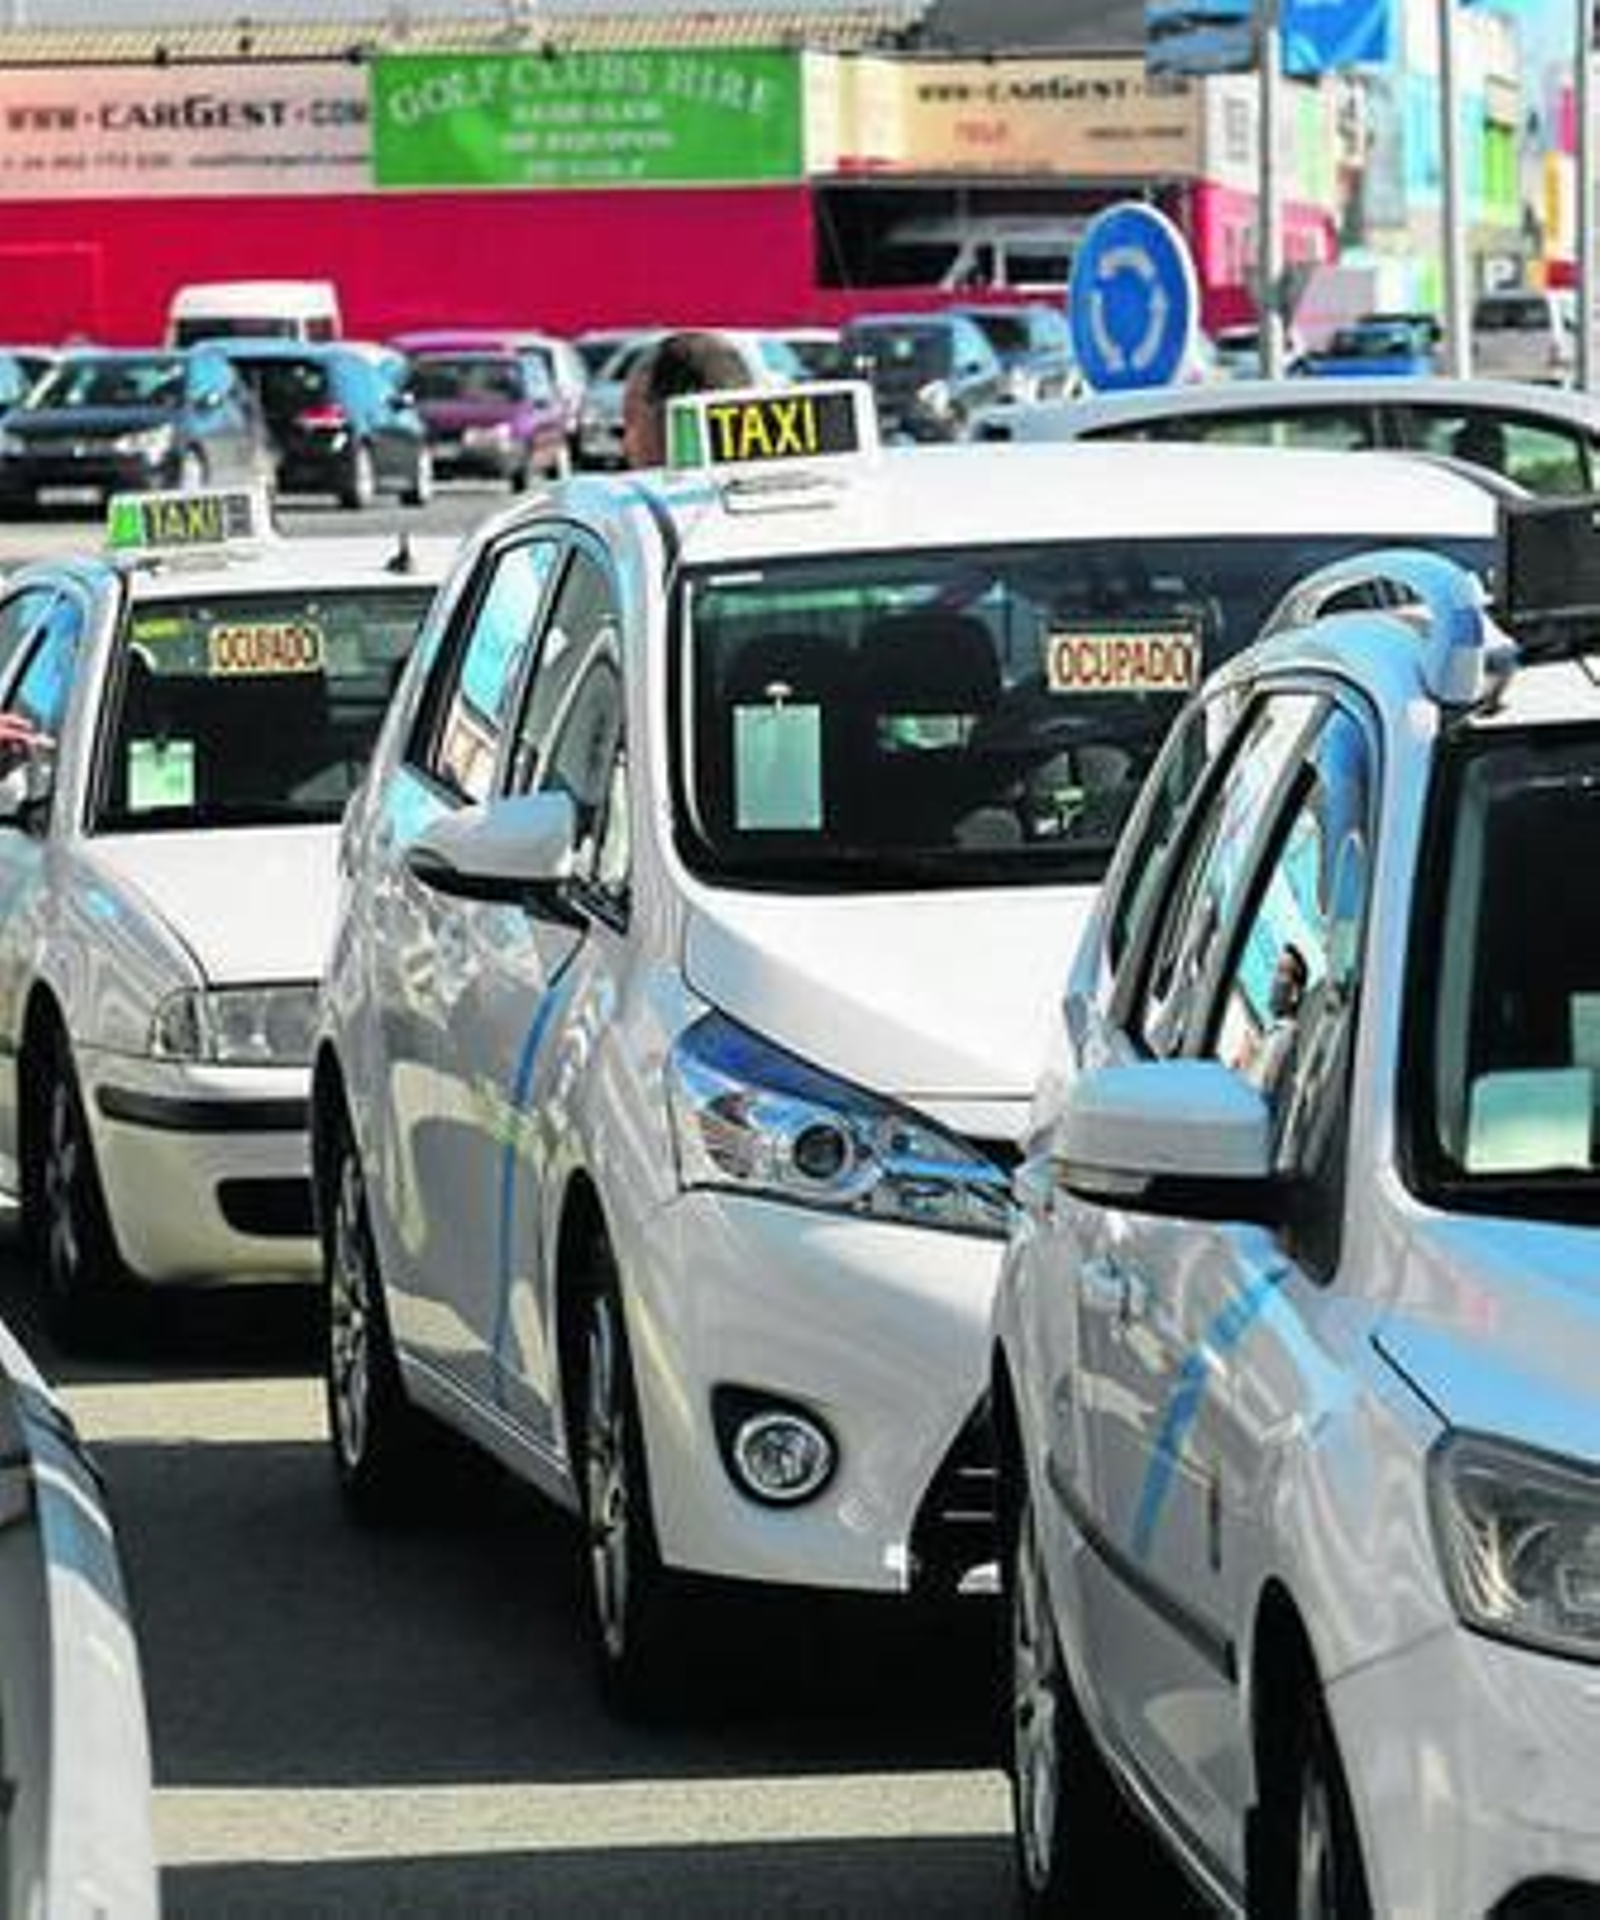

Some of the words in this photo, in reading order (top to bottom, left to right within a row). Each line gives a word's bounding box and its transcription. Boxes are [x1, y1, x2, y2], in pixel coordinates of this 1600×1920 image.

[388, 61, 501, 127] GOLF
[509, 54, 649, 98] CLUBS
[663, 55, 774, 114] HIRE
[708, 400, 816, 459] TAXI
[151, 498, 220, 538] TAXI
[215, 625, 318, 669] OCUPADO
[1055, 640, 1193, 686] OCUPADO
